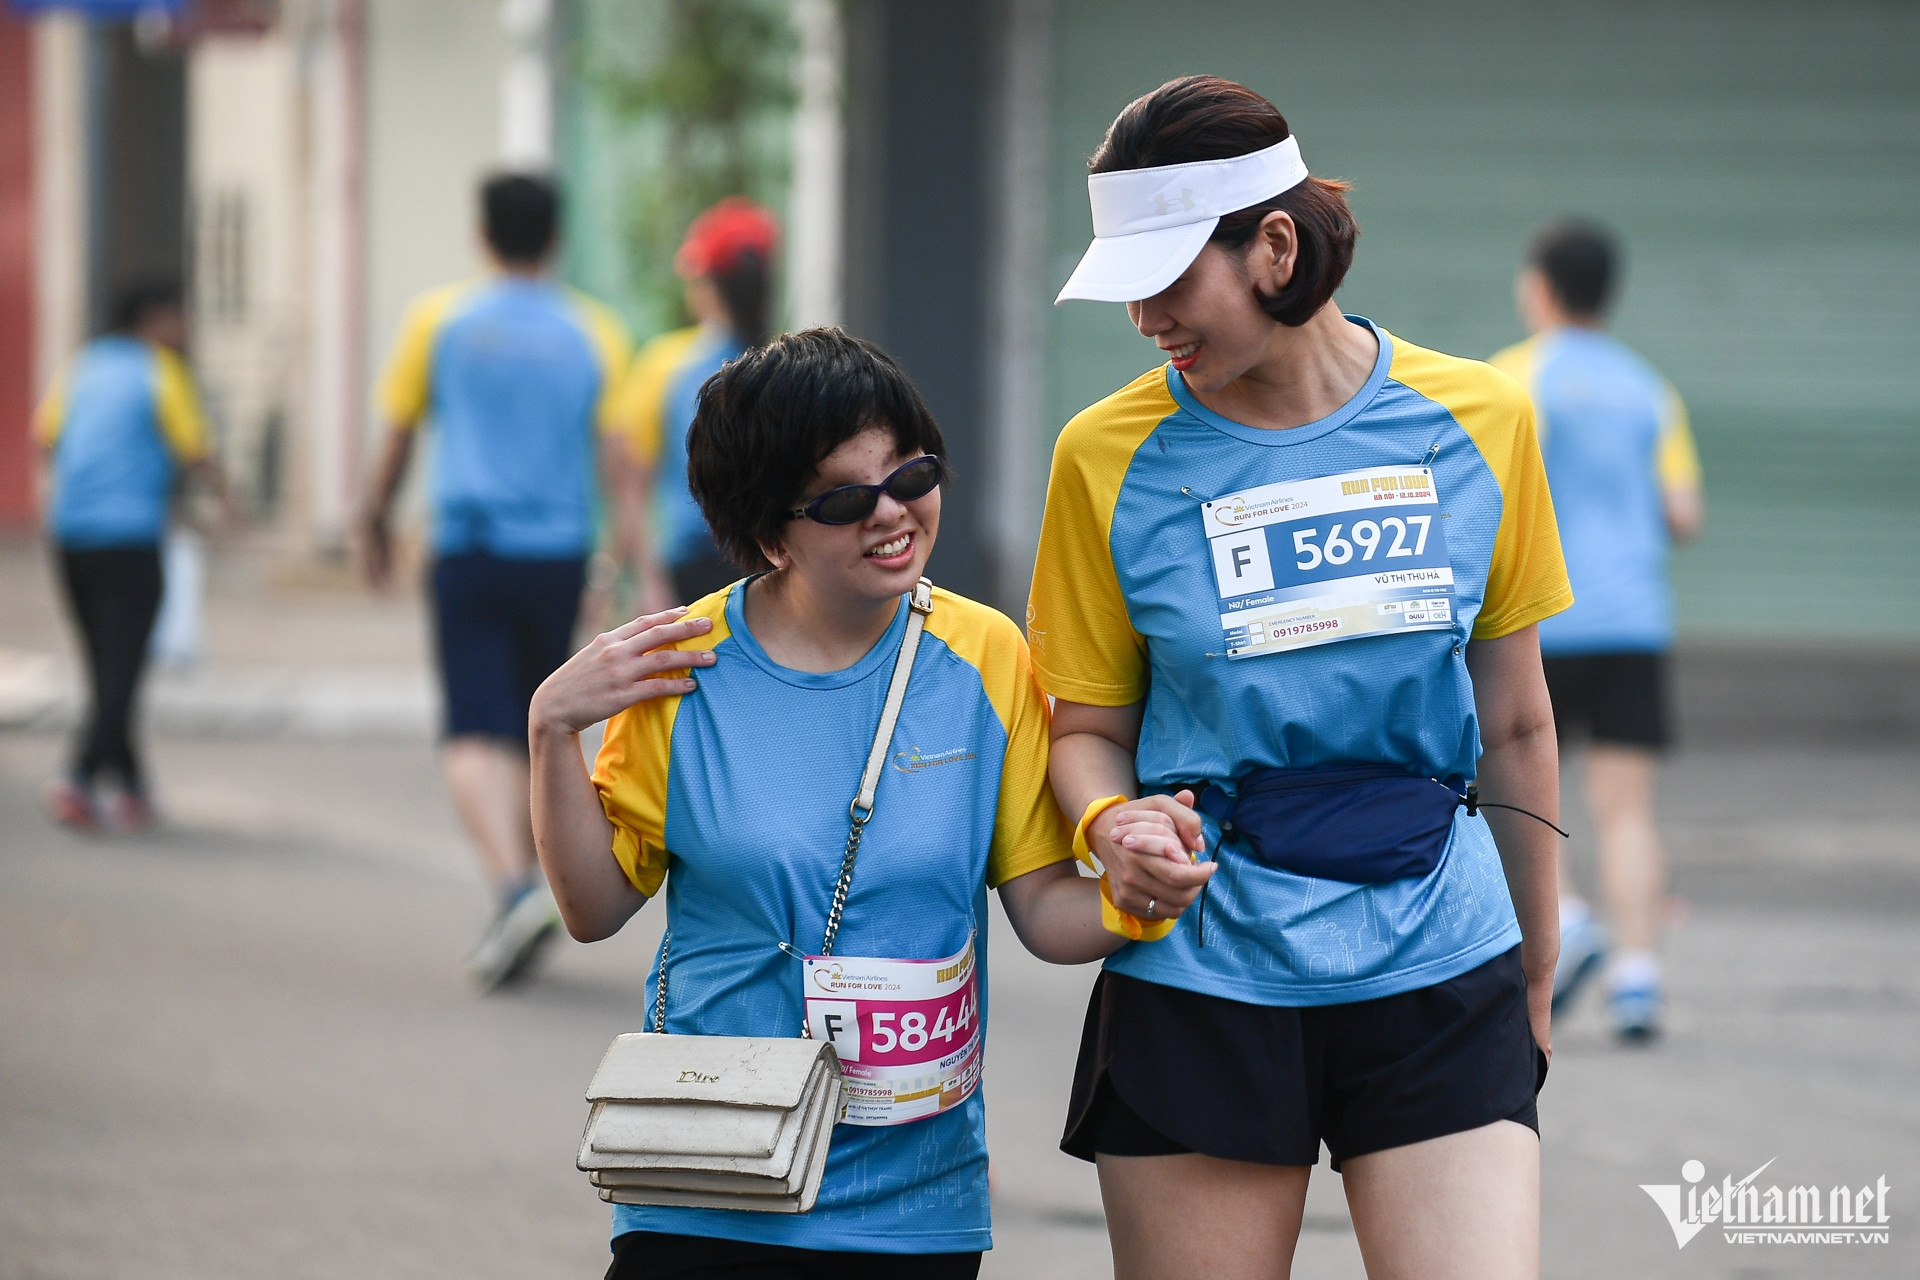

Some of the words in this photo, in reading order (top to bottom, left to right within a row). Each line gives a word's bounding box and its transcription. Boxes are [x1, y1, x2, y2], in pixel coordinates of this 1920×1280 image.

[1341, 479, 1370, 496] RUN
[1371, 476, 1398, 492] FOR
[1234, 513, 1251, 522] RUN
[1253, 509, 1268, 517] FOR
[1270, 505, 1290, 514] LOVE
[1291, 501, 1308, 510] 2024
[1292, 515, 1432, 571] 56927
[1231, 545, 1251, 578] F
[1407, 572, 1426, 581] THU
[1245, 595, 1275, 606] Female
[1268, 617, 1296, 626] EMERGENCY
[1273, 620, 1339, 638] 0919785998
[830, 981, 846, 989] RUN
[871, 981, 977, 1054] 58444
[824, 1014, 843, 1042] F
[849, 1066, 872, 1077] Female
[849, 1086, 893, 1097] 0919785998
